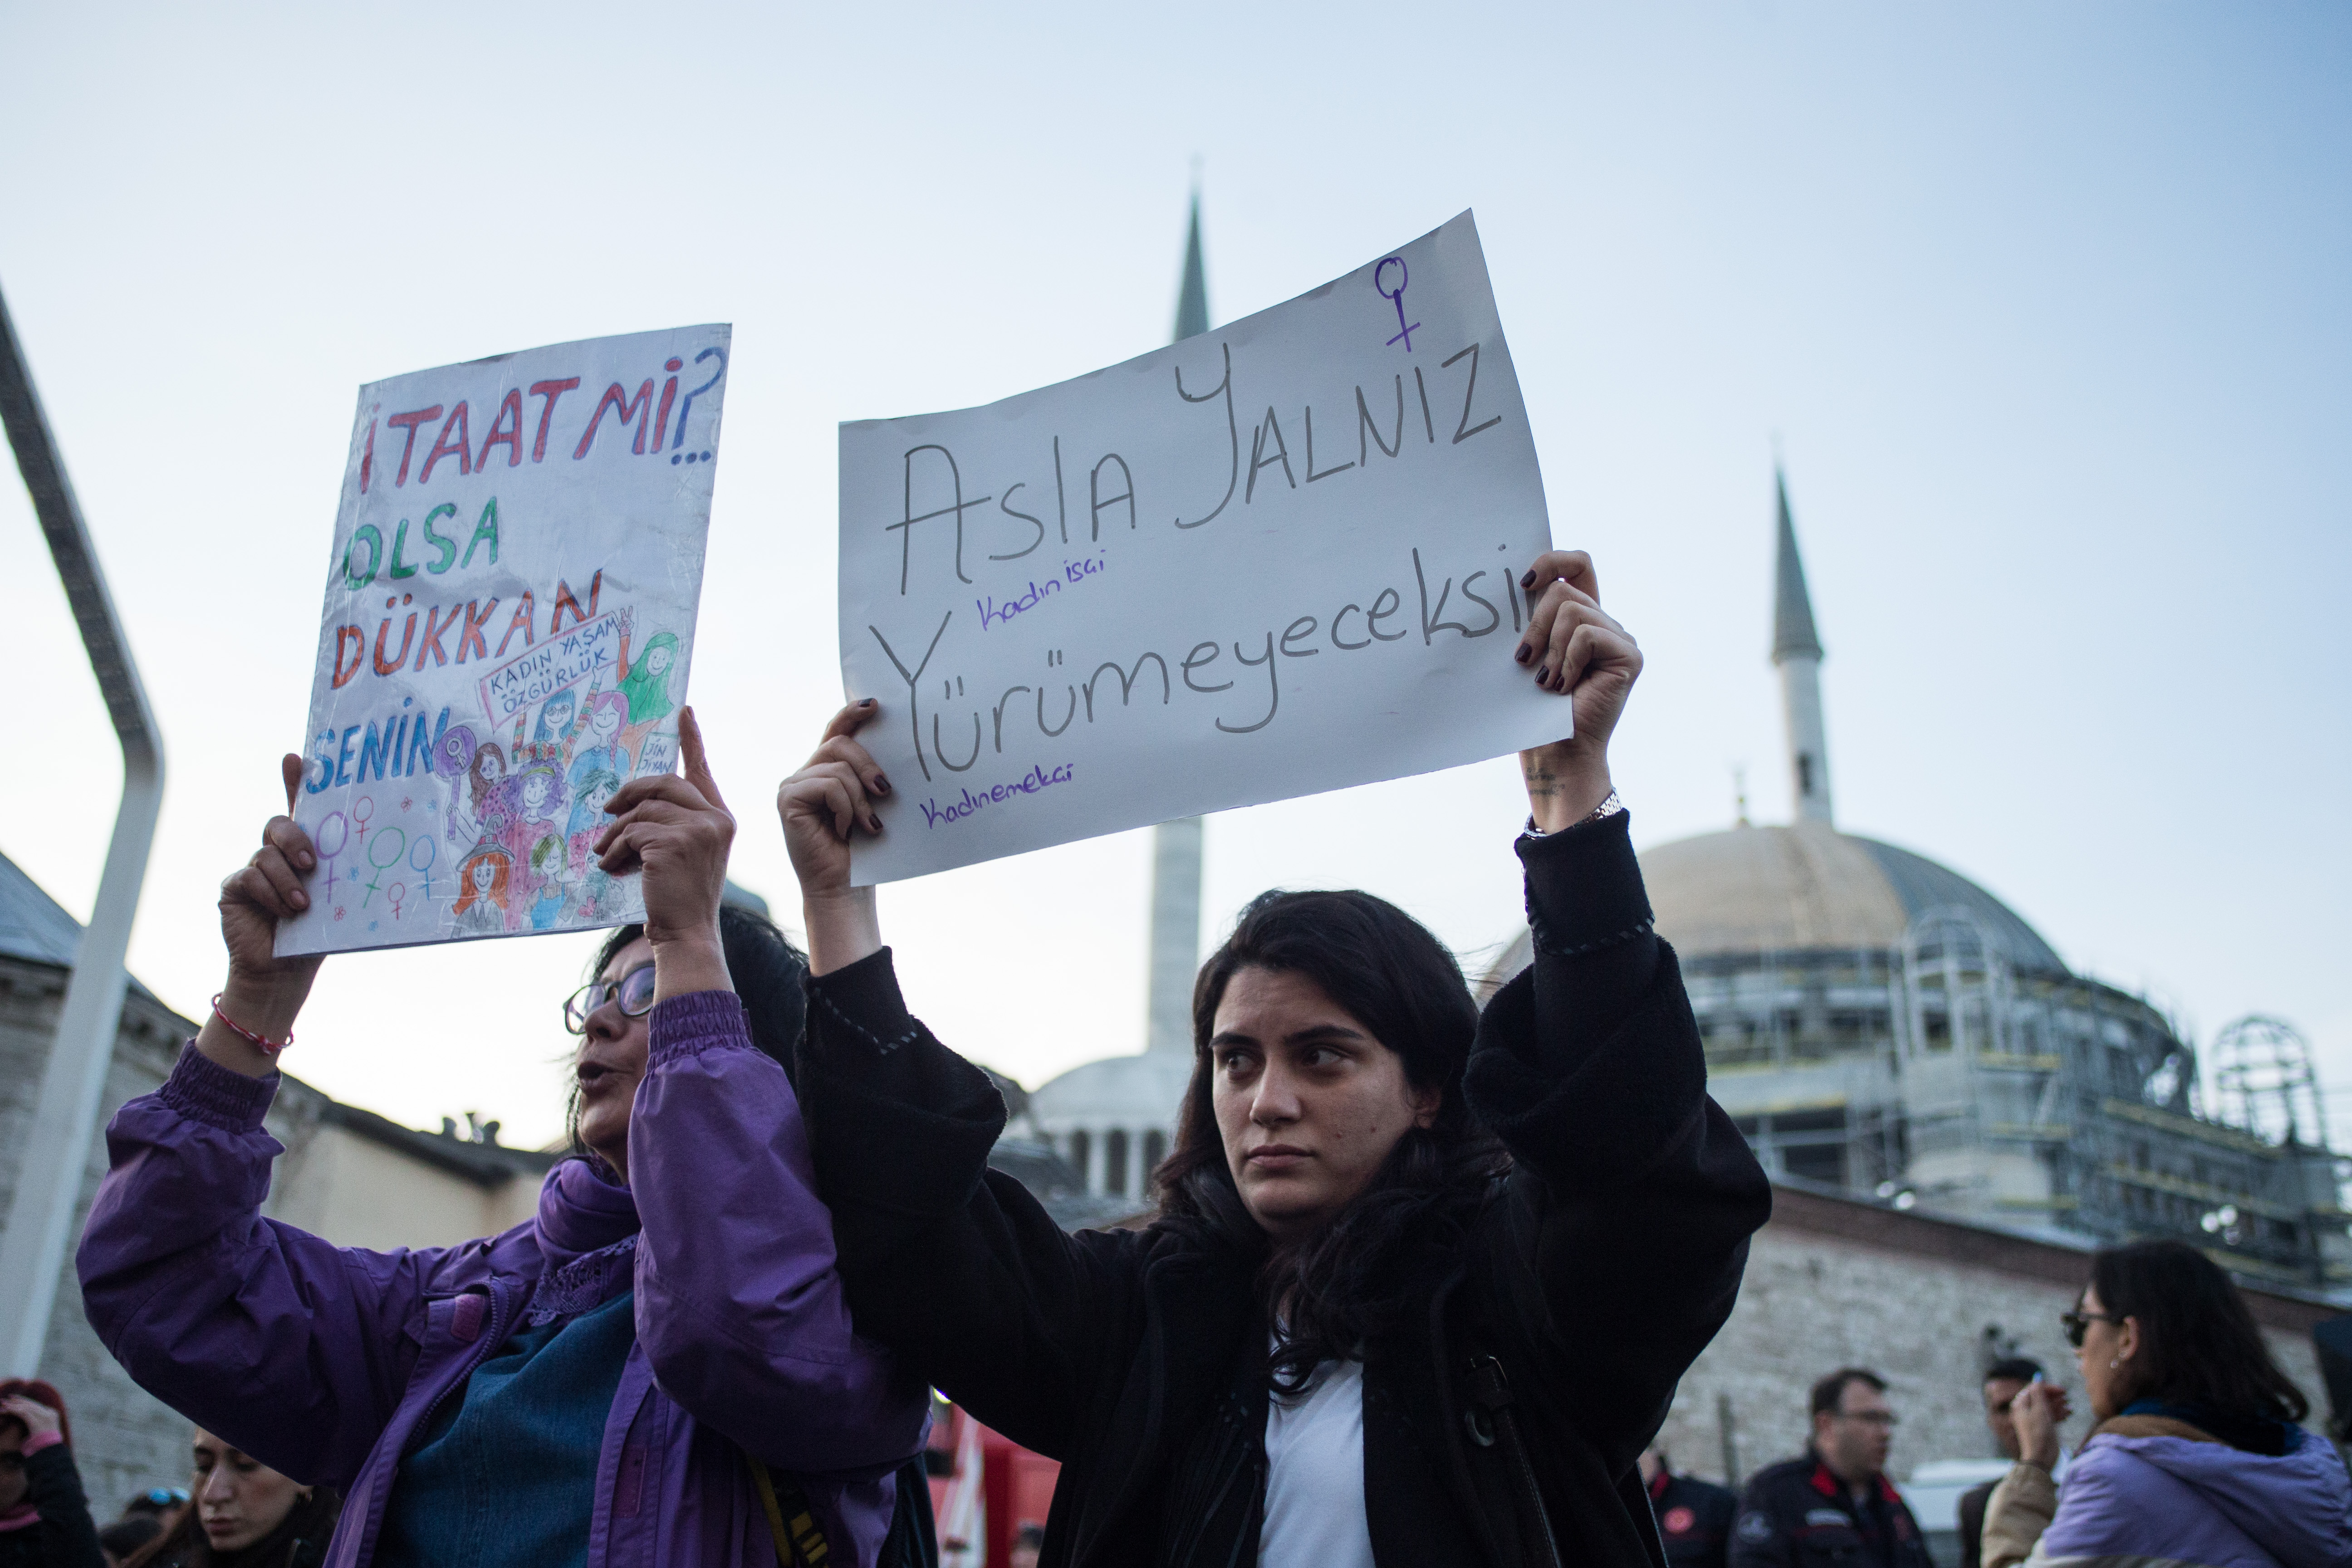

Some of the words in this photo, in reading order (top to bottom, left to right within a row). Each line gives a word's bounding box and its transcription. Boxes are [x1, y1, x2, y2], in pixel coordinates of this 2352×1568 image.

[342, 495, 499, 591] OLSA
[330, 568, 603, 691] DÜKKAN
[491, 648, 552, 695] KADIN
[559, 616, 621, 656] YAŞAM
[868, 543, 1537, 782] Yürümeyeceksi
[501, 647, 608, 713] ÖZGÜRLÜK
[305, 696, 451, 795] SENİN
